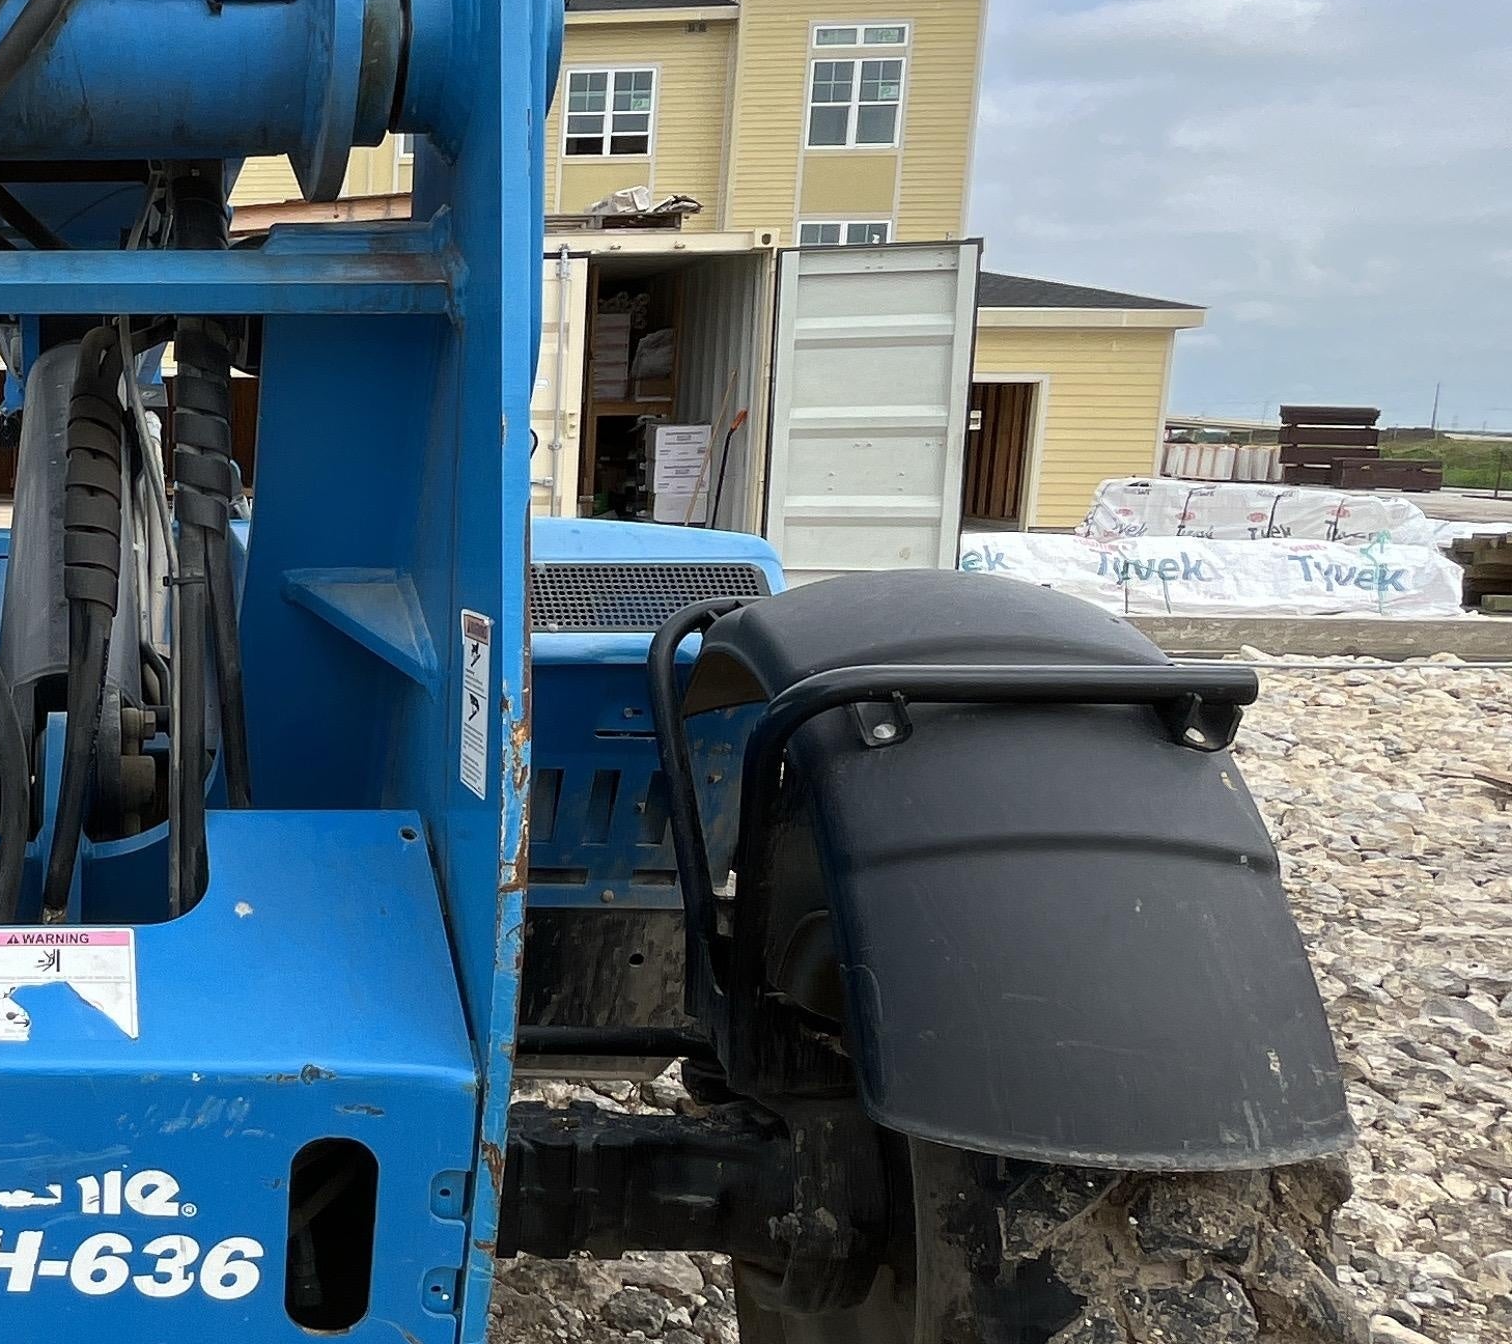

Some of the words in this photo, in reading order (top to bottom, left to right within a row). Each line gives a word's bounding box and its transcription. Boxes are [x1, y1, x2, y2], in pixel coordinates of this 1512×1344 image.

[1089, 547, 1212, 587] Tyvek
[1287, 554, 1409, 593] Tyvek
[21, 933, 90, 945] WARNING
